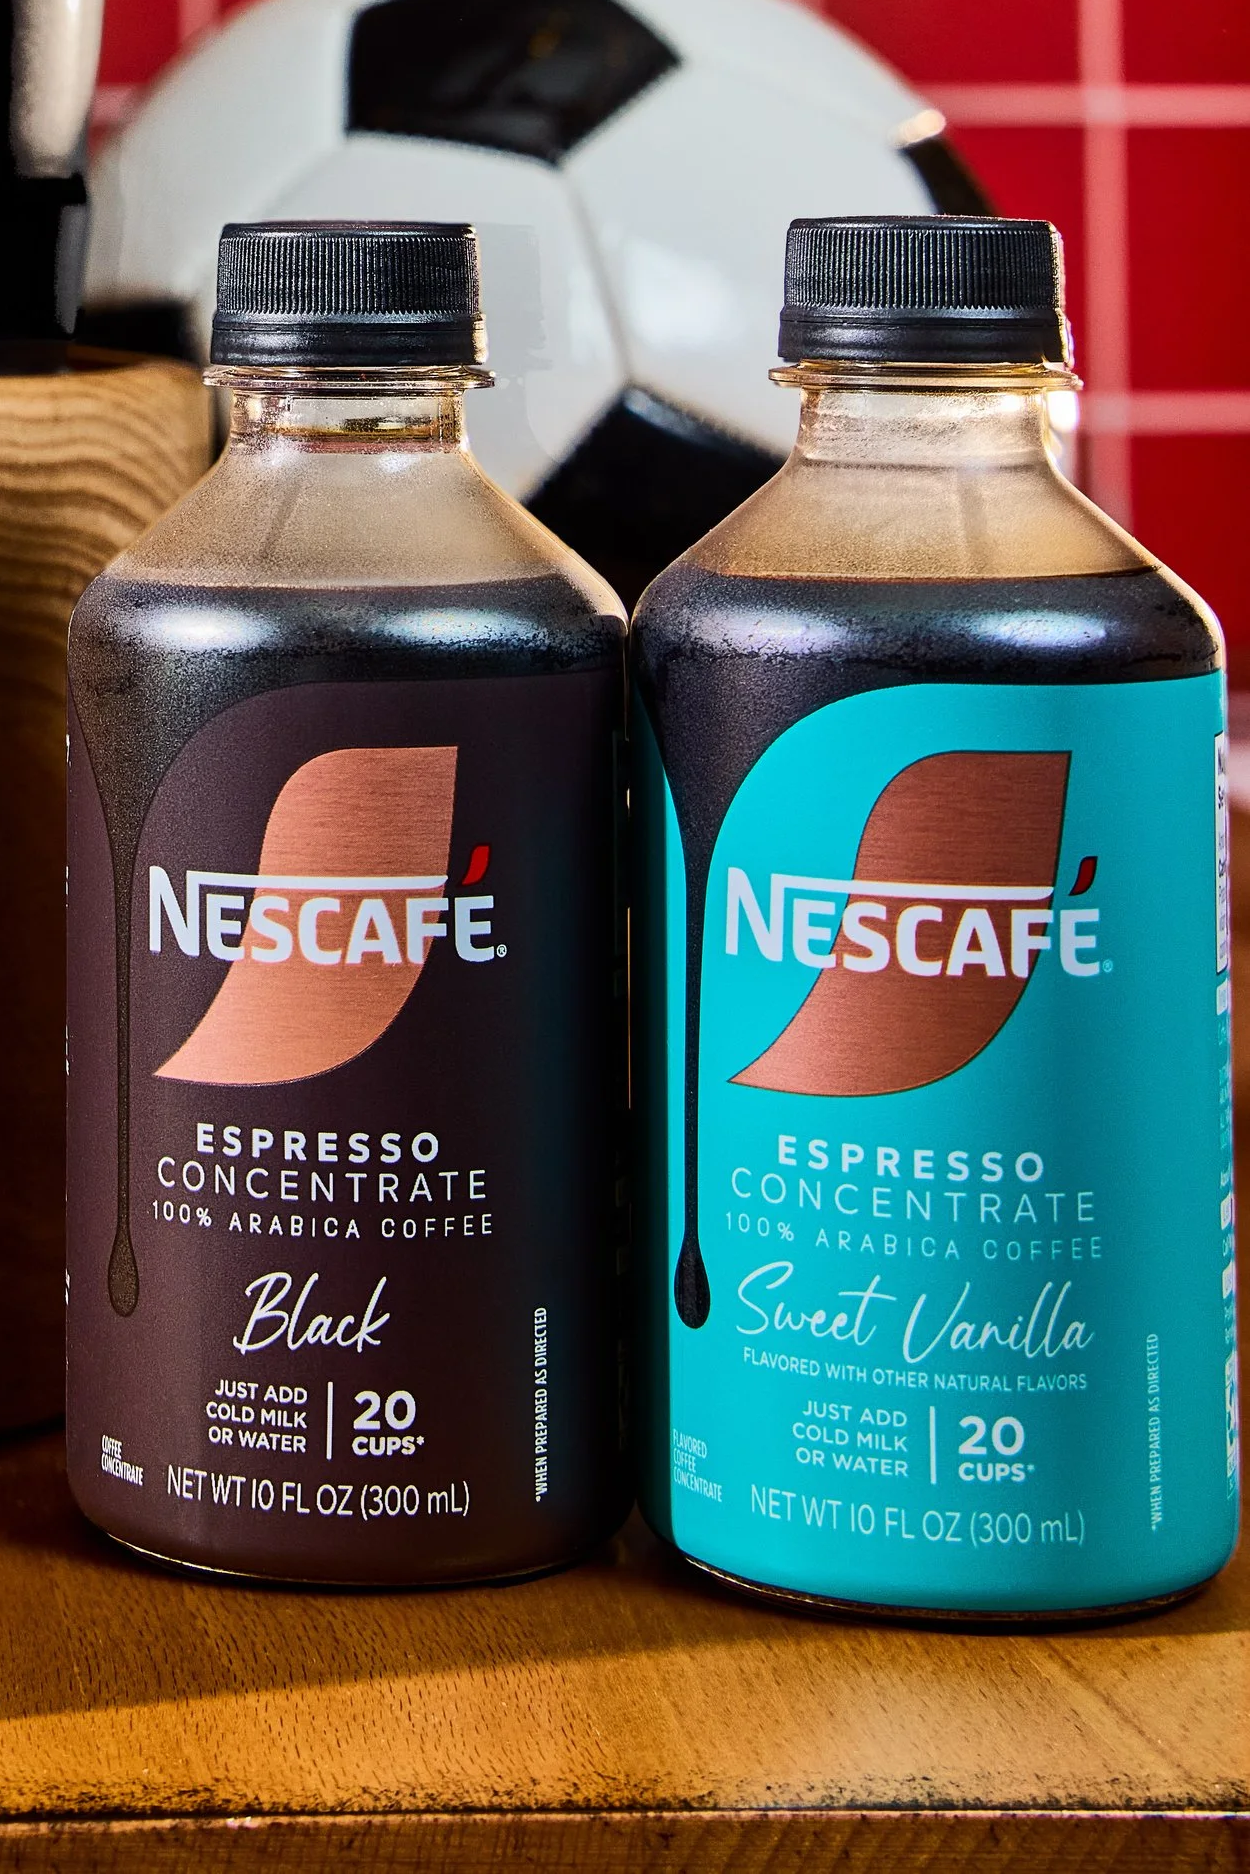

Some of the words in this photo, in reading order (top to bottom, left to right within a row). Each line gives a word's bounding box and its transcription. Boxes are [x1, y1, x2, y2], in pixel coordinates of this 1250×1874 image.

[197, 1123, 439, 1163] ESPRESSO
[779, 1134, 1043, 1182] ESPRESSO
[158, 1157, 486, 1202] CONCENTRATE
[732, 1167, 1094, 1223] CONCENTRATE
[152, 1200, 211, 1227] 100%
[230, 1211, 360, 1238] ARABICA
[381, 1214, 493, 1238] COFFEE
[726, 1211, 795, 1241] 100%
[816, 1227, 960, 1261] ARABICA
[983, 1237, 1102, 1261] COFFEE
[233, 1272, 390, 1355] Black
[736, 1261, 896, 1346] Sweet
[903, 1281, 1094, 1363] Vanilla
[534, 1307, 547, 1367] DIRECTED
[534, 1369, 547, 1385] AS
[743, 1347, 820, 1378] FLAVORED
[826, 1363, 866, 1383] WITH
[873, 1368, 928, 1388] OTHER
[934, 1373, 1012, 1392] NATURAL
[1017, 1373, 1087, 1392] FLAVORS
[1147, 1334, 1158, 1393] DIRECTED
[214, 1380, 258, 1400] JUST
[264, 1385, 307, 1405] ADD
[353, 1391, 416, 1429] 20
[1147, 1396, 1160, 1412] AS
[206, 1402, 254, 1424] COLD
[261, 1408, 307, 1429] MILK
[534, 1389, 547, 1454] PREPARED
[802, 1400, 853, 1423] JUST
[860, 1407, 907, 1427] ADD
[102, 1435, 122, 1459] COFFEE
[208, 1427, 234, 1446] OR
[238, 1431, 307, 1453] WATER
[673, 1429, 707, 1458] FLAVORED
[792, 1423, 849, 1446] COLD
[857, 1429, 907, 1452] MILK
[959, 1416, 1025, 1455] 20
[1148, 1417, 1161, 1482] PREPARED
[102, 1452, 144, 1486] CONCENTRATE
[673, 1448, 696, 1472] COFFEE
[796, 1448, 826, 1467] OR
[832, 1452, 908, 1477] WATER
[167, 1465, 206, 1502] NET
[211, 1473, 245, 1509] WT
[251, 1478, 274, 1511] 10
[282, 1482, 309, 1514] FL
[316, 1484, 353, 1516] OZ
[360, 1485, 419, 1520] (300
[427, 1482, 469, 1516] mL)
[673, 1467, 722, 1503] CONCENTRATE
[751, 1483, 797, 1522] NET
[802, 1497, 842, 1529] WT
[850, 1503, 875, 1535] 10
[885, 1508, 914, 1539] FL
[923, 1510, 960, 1541] OZ
[970, 1513, 1034, 1548] (300
[1041, 1510, 1085, 1546] mL)
